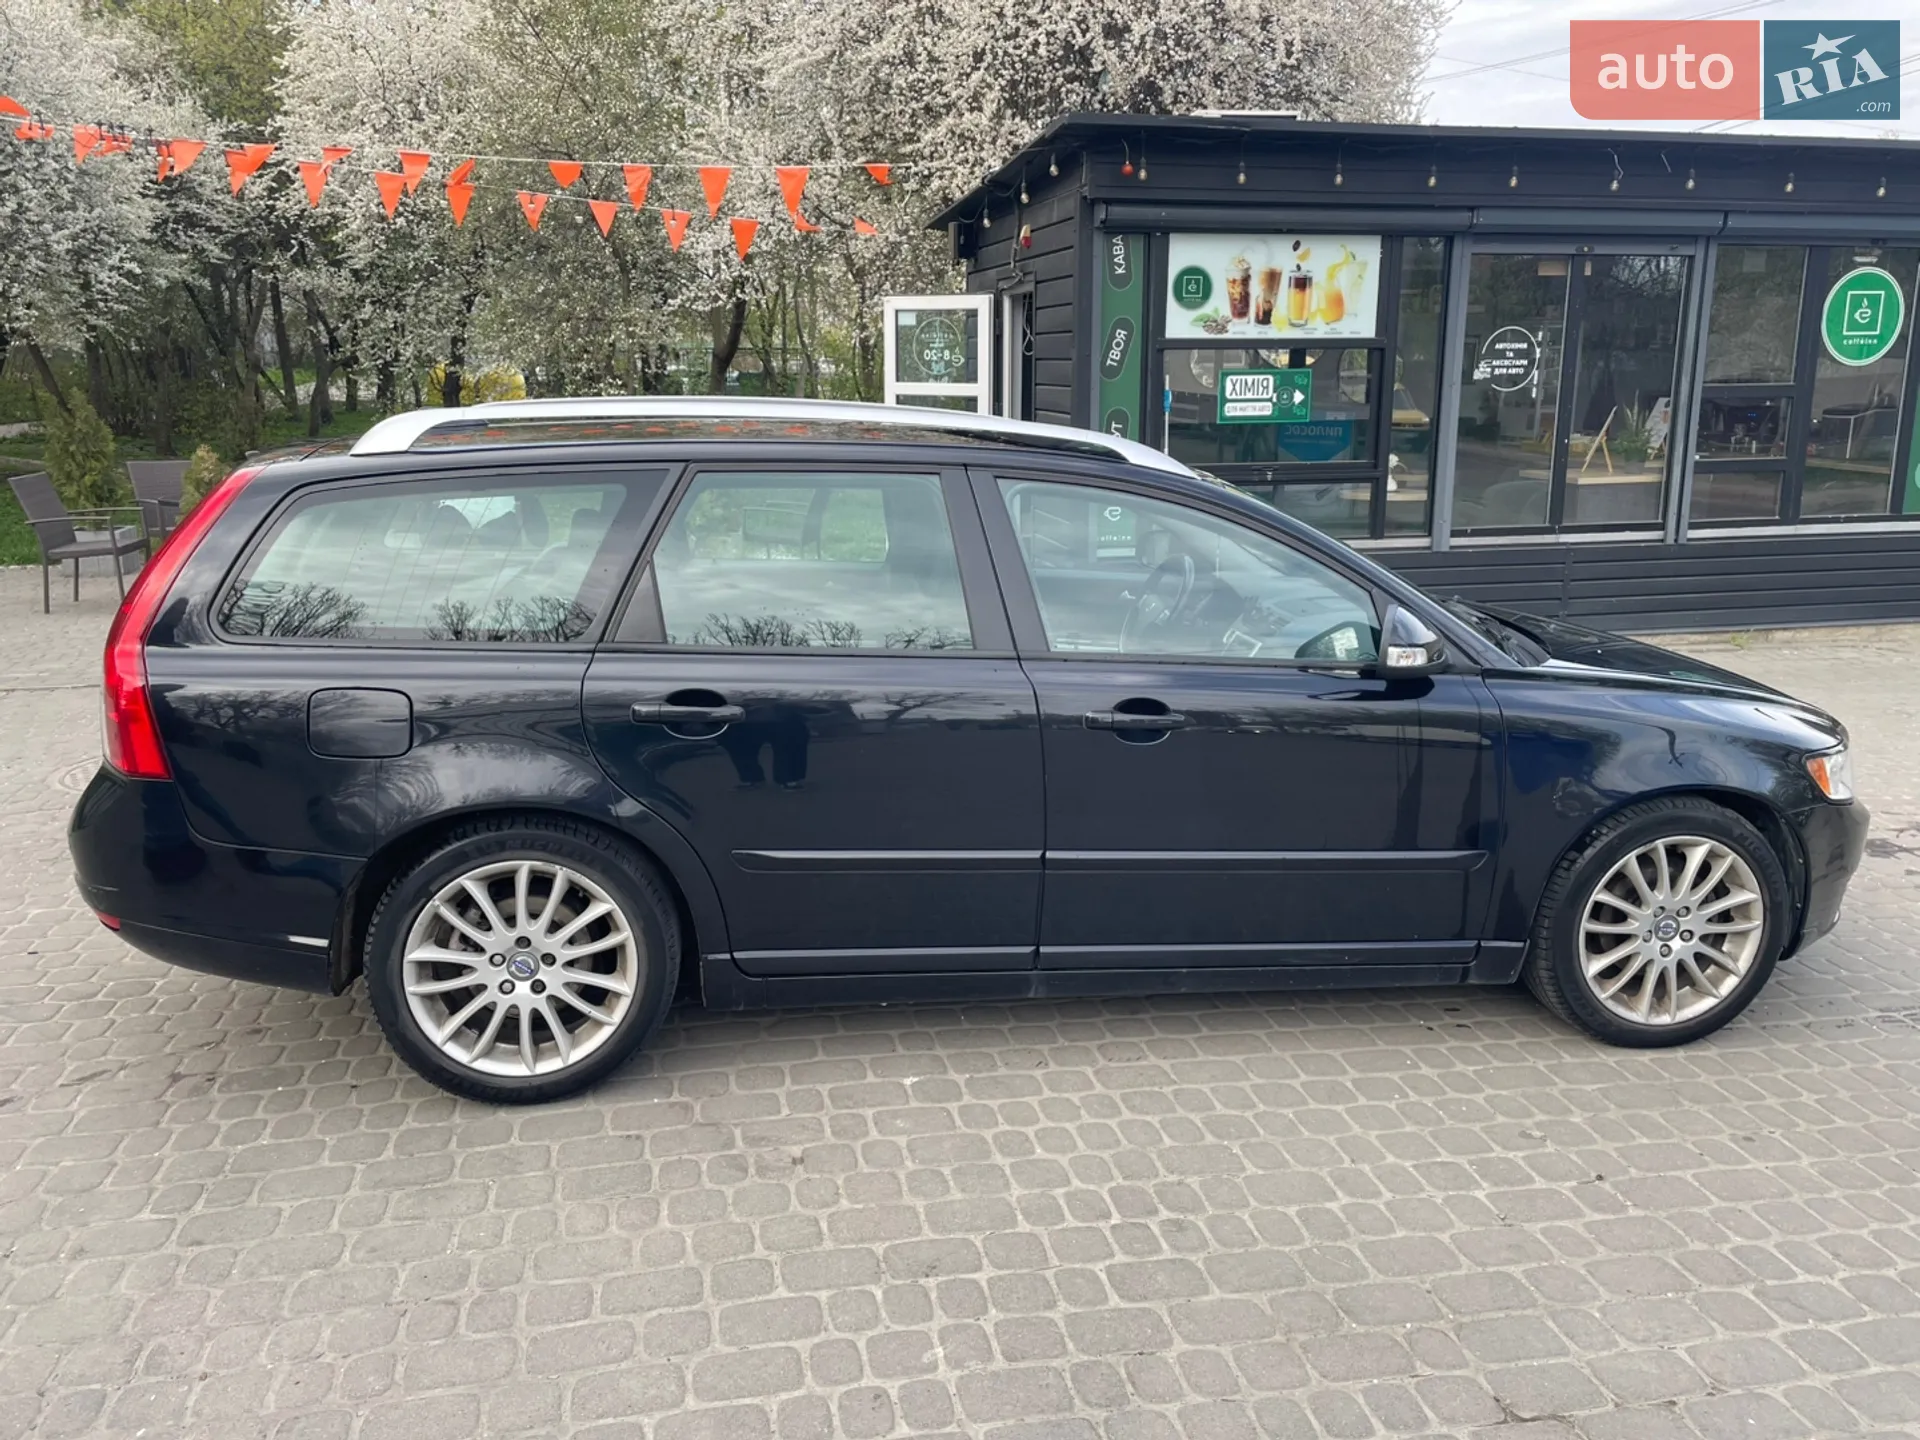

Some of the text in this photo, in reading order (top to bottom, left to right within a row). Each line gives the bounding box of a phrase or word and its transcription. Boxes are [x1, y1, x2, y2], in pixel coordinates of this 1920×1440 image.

[1112, 235, 1126, 275] КАВА
[1106, 329, 1128, 367] ТВОЯ
[1229, 378, 1270, 397] ХІМІЯ
